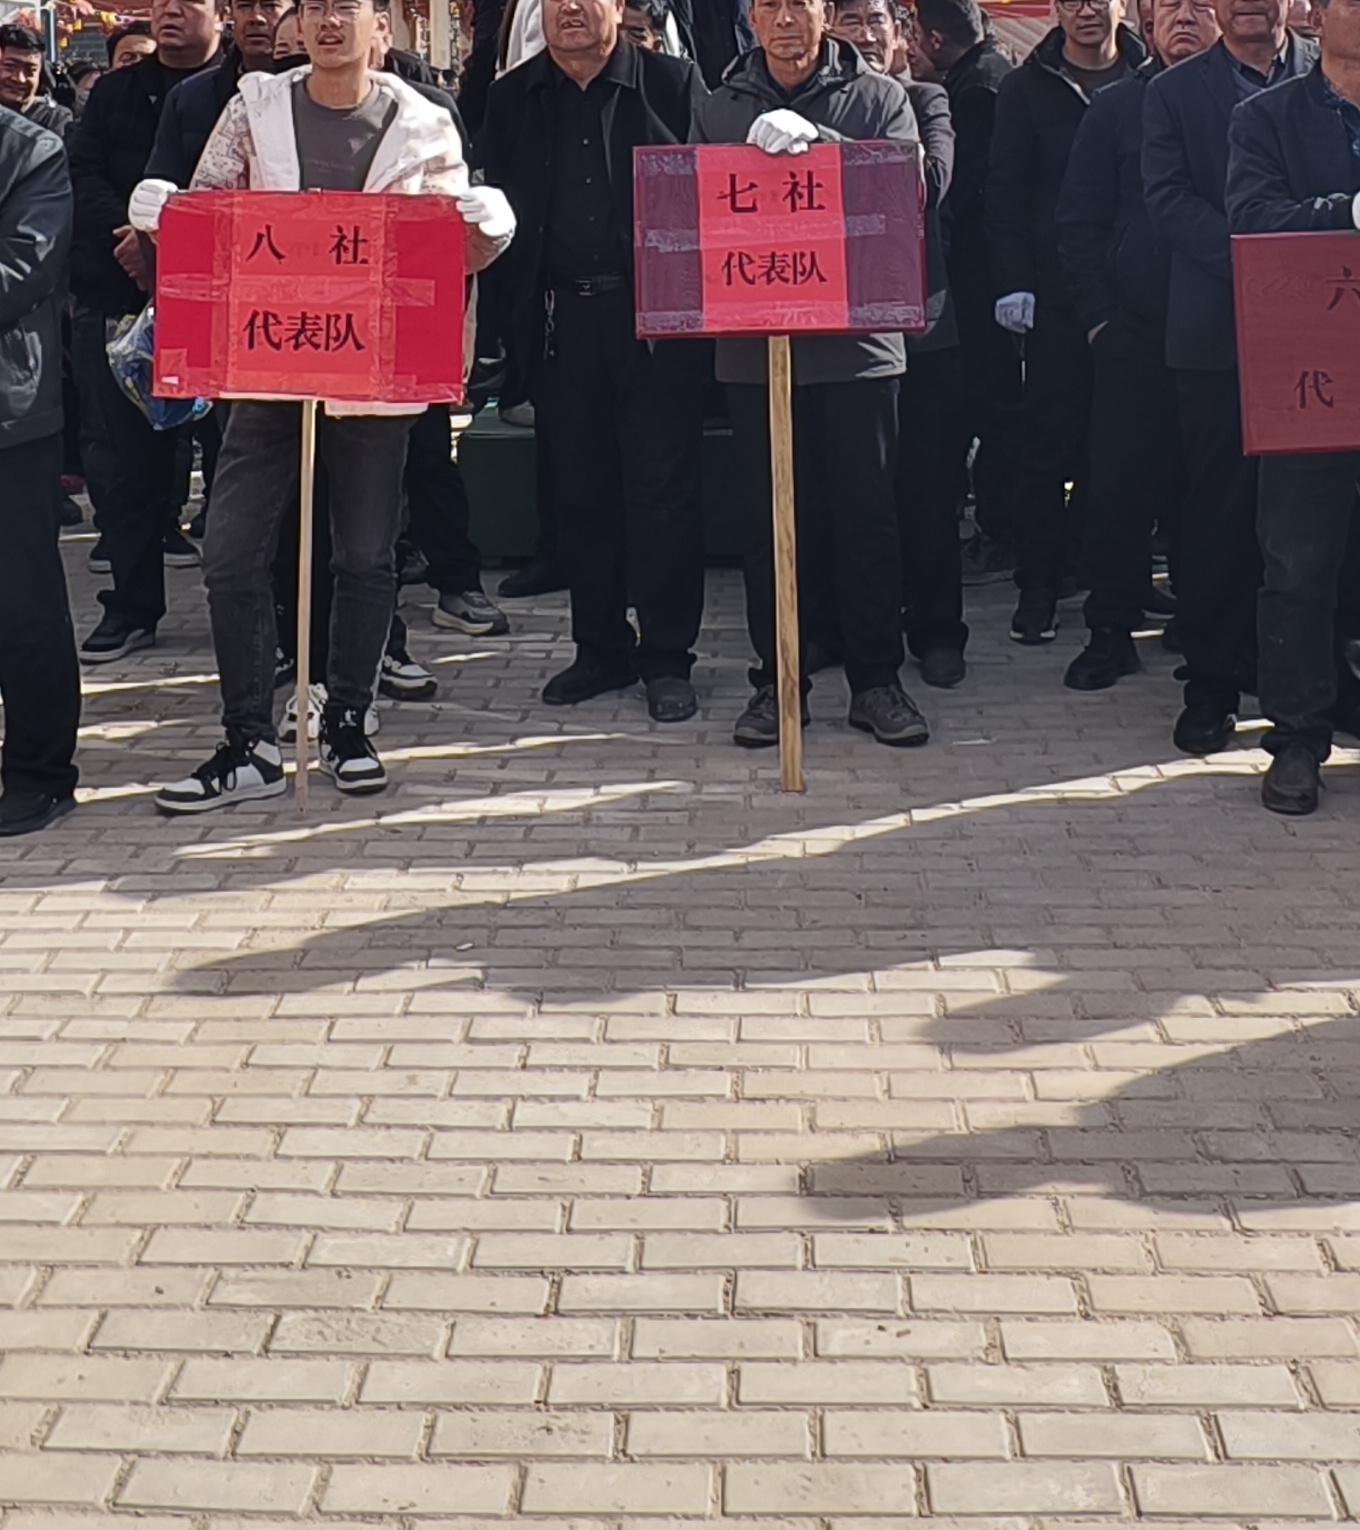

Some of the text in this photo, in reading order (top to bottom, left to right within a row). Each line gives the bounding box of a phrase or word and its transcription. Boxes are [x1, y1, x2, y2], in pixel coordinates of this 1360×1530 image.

[716, 170, 826, 214] 七社
[246, 224, 370, 267] 八社
[721, 250, 828, 289] 代表队
[243, 308, 366, 353] 代表队
